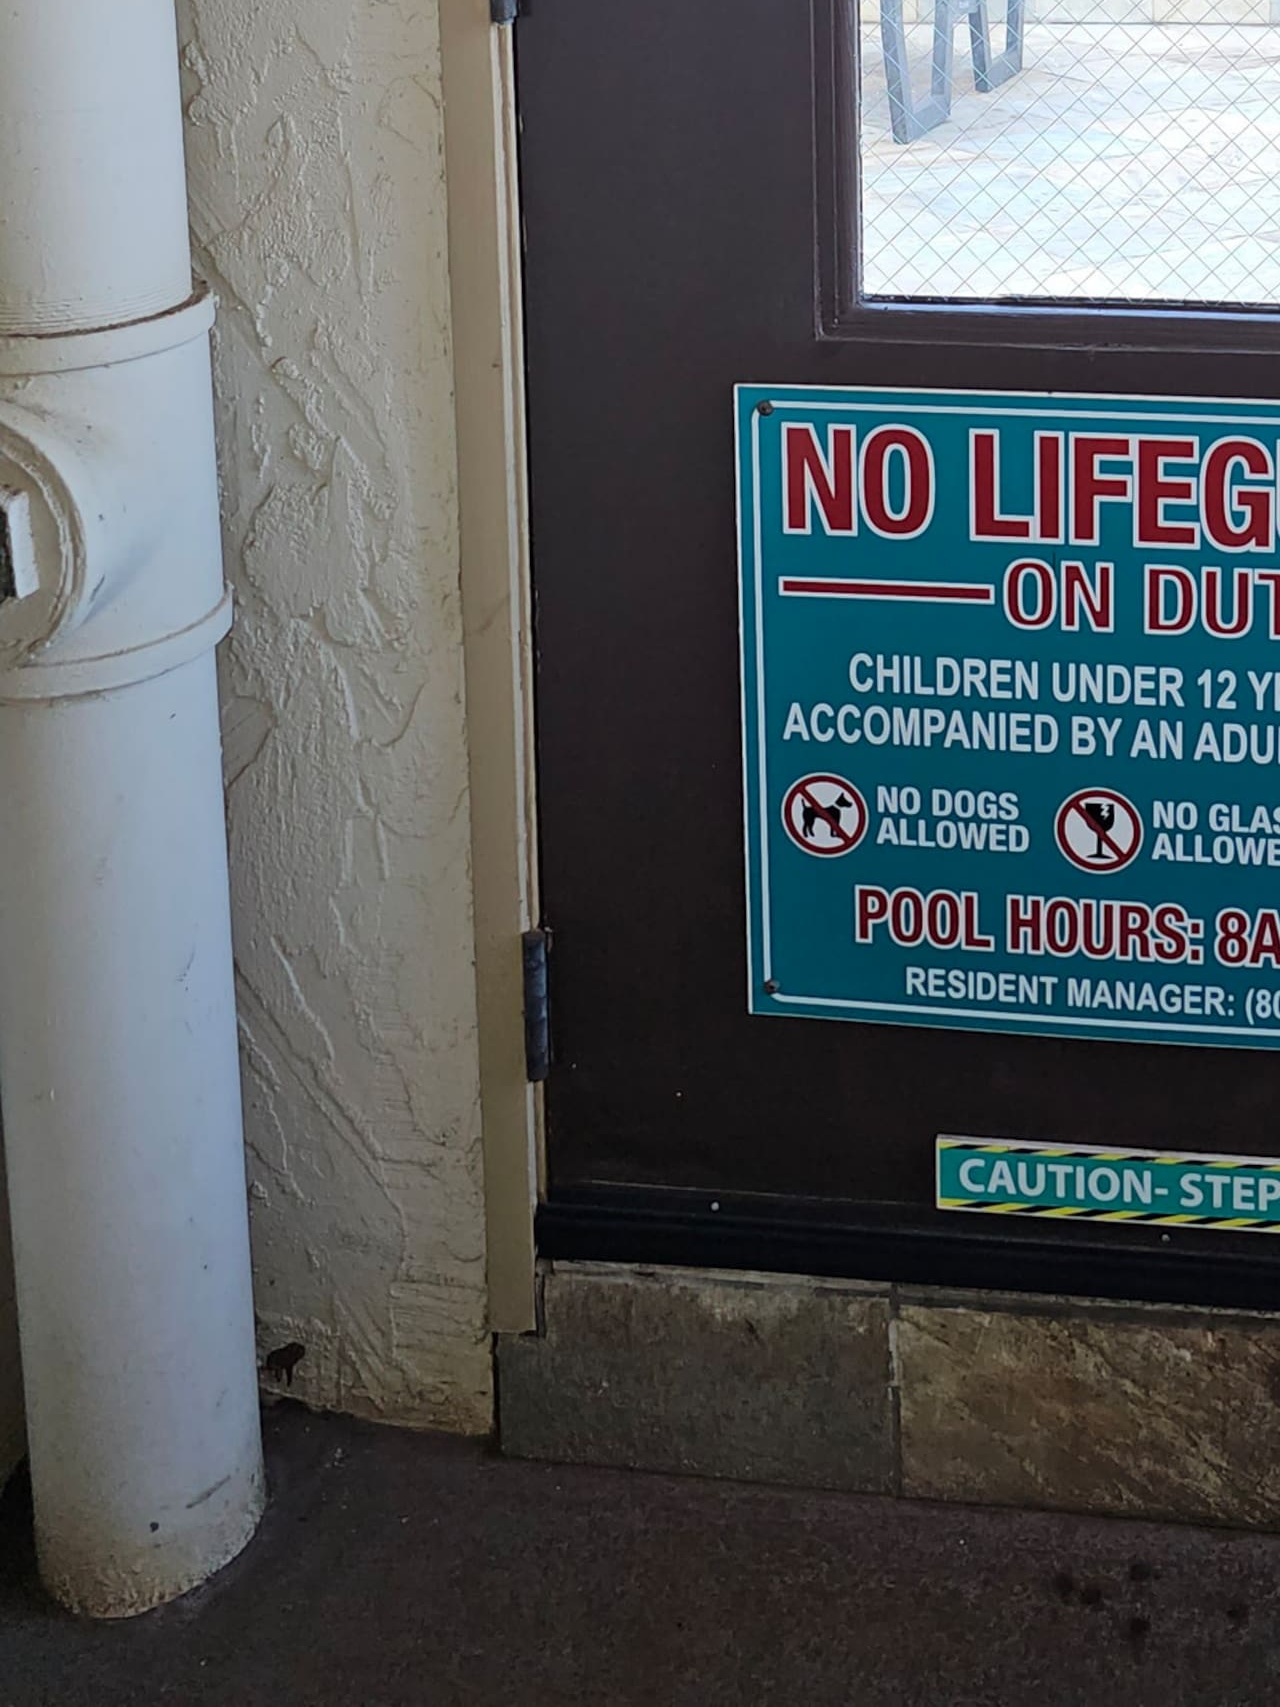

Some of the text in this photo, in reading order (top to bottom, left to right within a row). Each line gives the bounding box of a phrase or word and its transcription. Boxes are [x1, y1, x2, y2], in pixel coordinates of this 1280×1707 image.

[781, 422, 935, 539] NO
[1003, 558, 1114, 632] ON
[850, 653, 1038, 699] CHILDREN
[1053, 663, 1184, 706] UNDER
[1198, 670, 1236, 709] 12
[784, 703, 1058, 752] ACCOMPANIED
[1072, 716, 1122, 756] BY
[1131, 720, 1182, 759] AN
[878, 786, 1018, 820] NO DOGS
[1154, 801, 1197, 830] NO
[877, 818, 1029, 851] ALLOWED
[855, 885, 994, 951] POOL
[1007, 895, 1204, 964] HOURS:
[907, 967, 1057, 1004] RESIDENT
[1068, 978, 1233, 1015] MANAGER:
